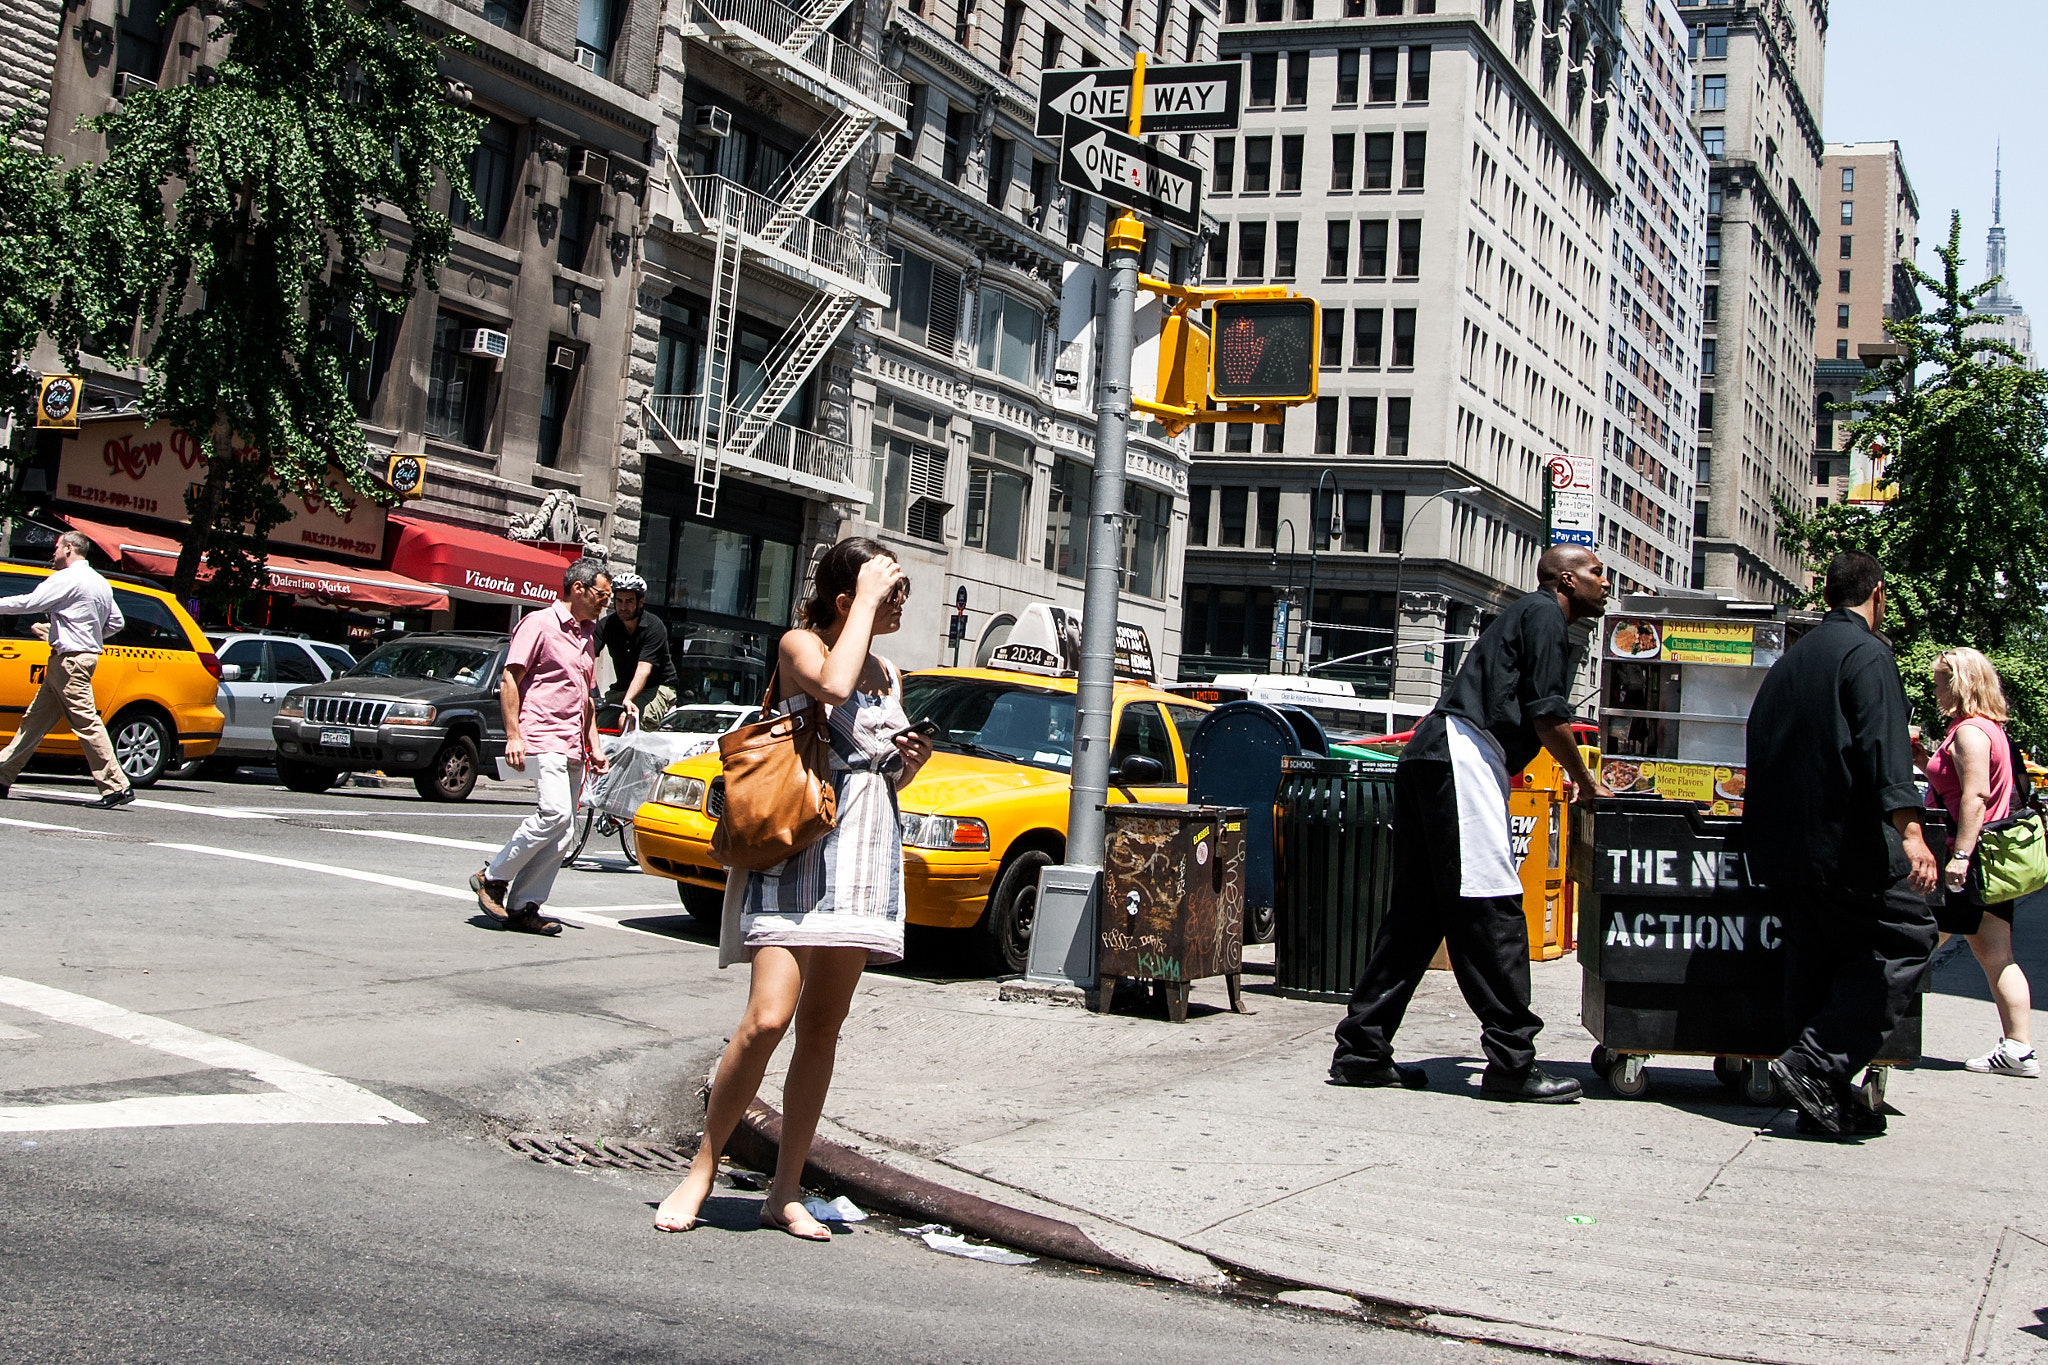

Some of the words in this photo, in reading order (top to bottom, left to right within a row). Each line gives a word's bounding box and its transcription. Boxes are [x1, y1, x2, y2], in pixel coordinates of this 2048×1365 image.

[1070, 90, 1125, 115] ONE
[1154, 85, 1215, 112] WAY
[1086, 145, 1127, 182] ONE
[1146, 166, 1185, 205] WAY
[49, 379, 73, 391] BAKERY
[47, 391, 71, 405] Café
[103, 434, 163, 480] New
[397, 458, 418, 468] BAKERY
[395, 468, 417, 480] Café
[1555, 531, 1571, 543] Pay
[1571, 532, 1581, 541] at
[268, 572, 316, 590] Valentino
[317, 579, 351, 596] Market
[464, 569, 515, 593] Victoria
[520, 581, 558, 601] Salon
[350, 627, 371, 638] ATM
[1668, 621, 1708, 634] SPECIAL
[1714, 622, 1750, 636] $3.99
[101, 648, 121, 657] Y73
[1010, 647, 1042, 664] 2D34
[1680, 653, 1703, 662] Limited
[1704, 655, 1720, 663] Time
[1721, 656, 1737, 664] Only
[1192, 690, 1219, 701] LIMITED
[1289, 760, 1316, 769] SCHOOL
[1657, 764, 1676, 773] More
[1678, 765, 1711, 777] Toppings
[1657, 775, 1677, 784] More
[1677, 776, 1704, 787] Flavors
[1656, 787, 1676, 796] Same
[1677, 788, 1696, 798] Price
[1510, 815, 1538, 834] EW
[1607, 849, 1678, 886] THE
[1691, 850, 1766, 888] NE
[1605, 911, 1745, 951] ACTION
